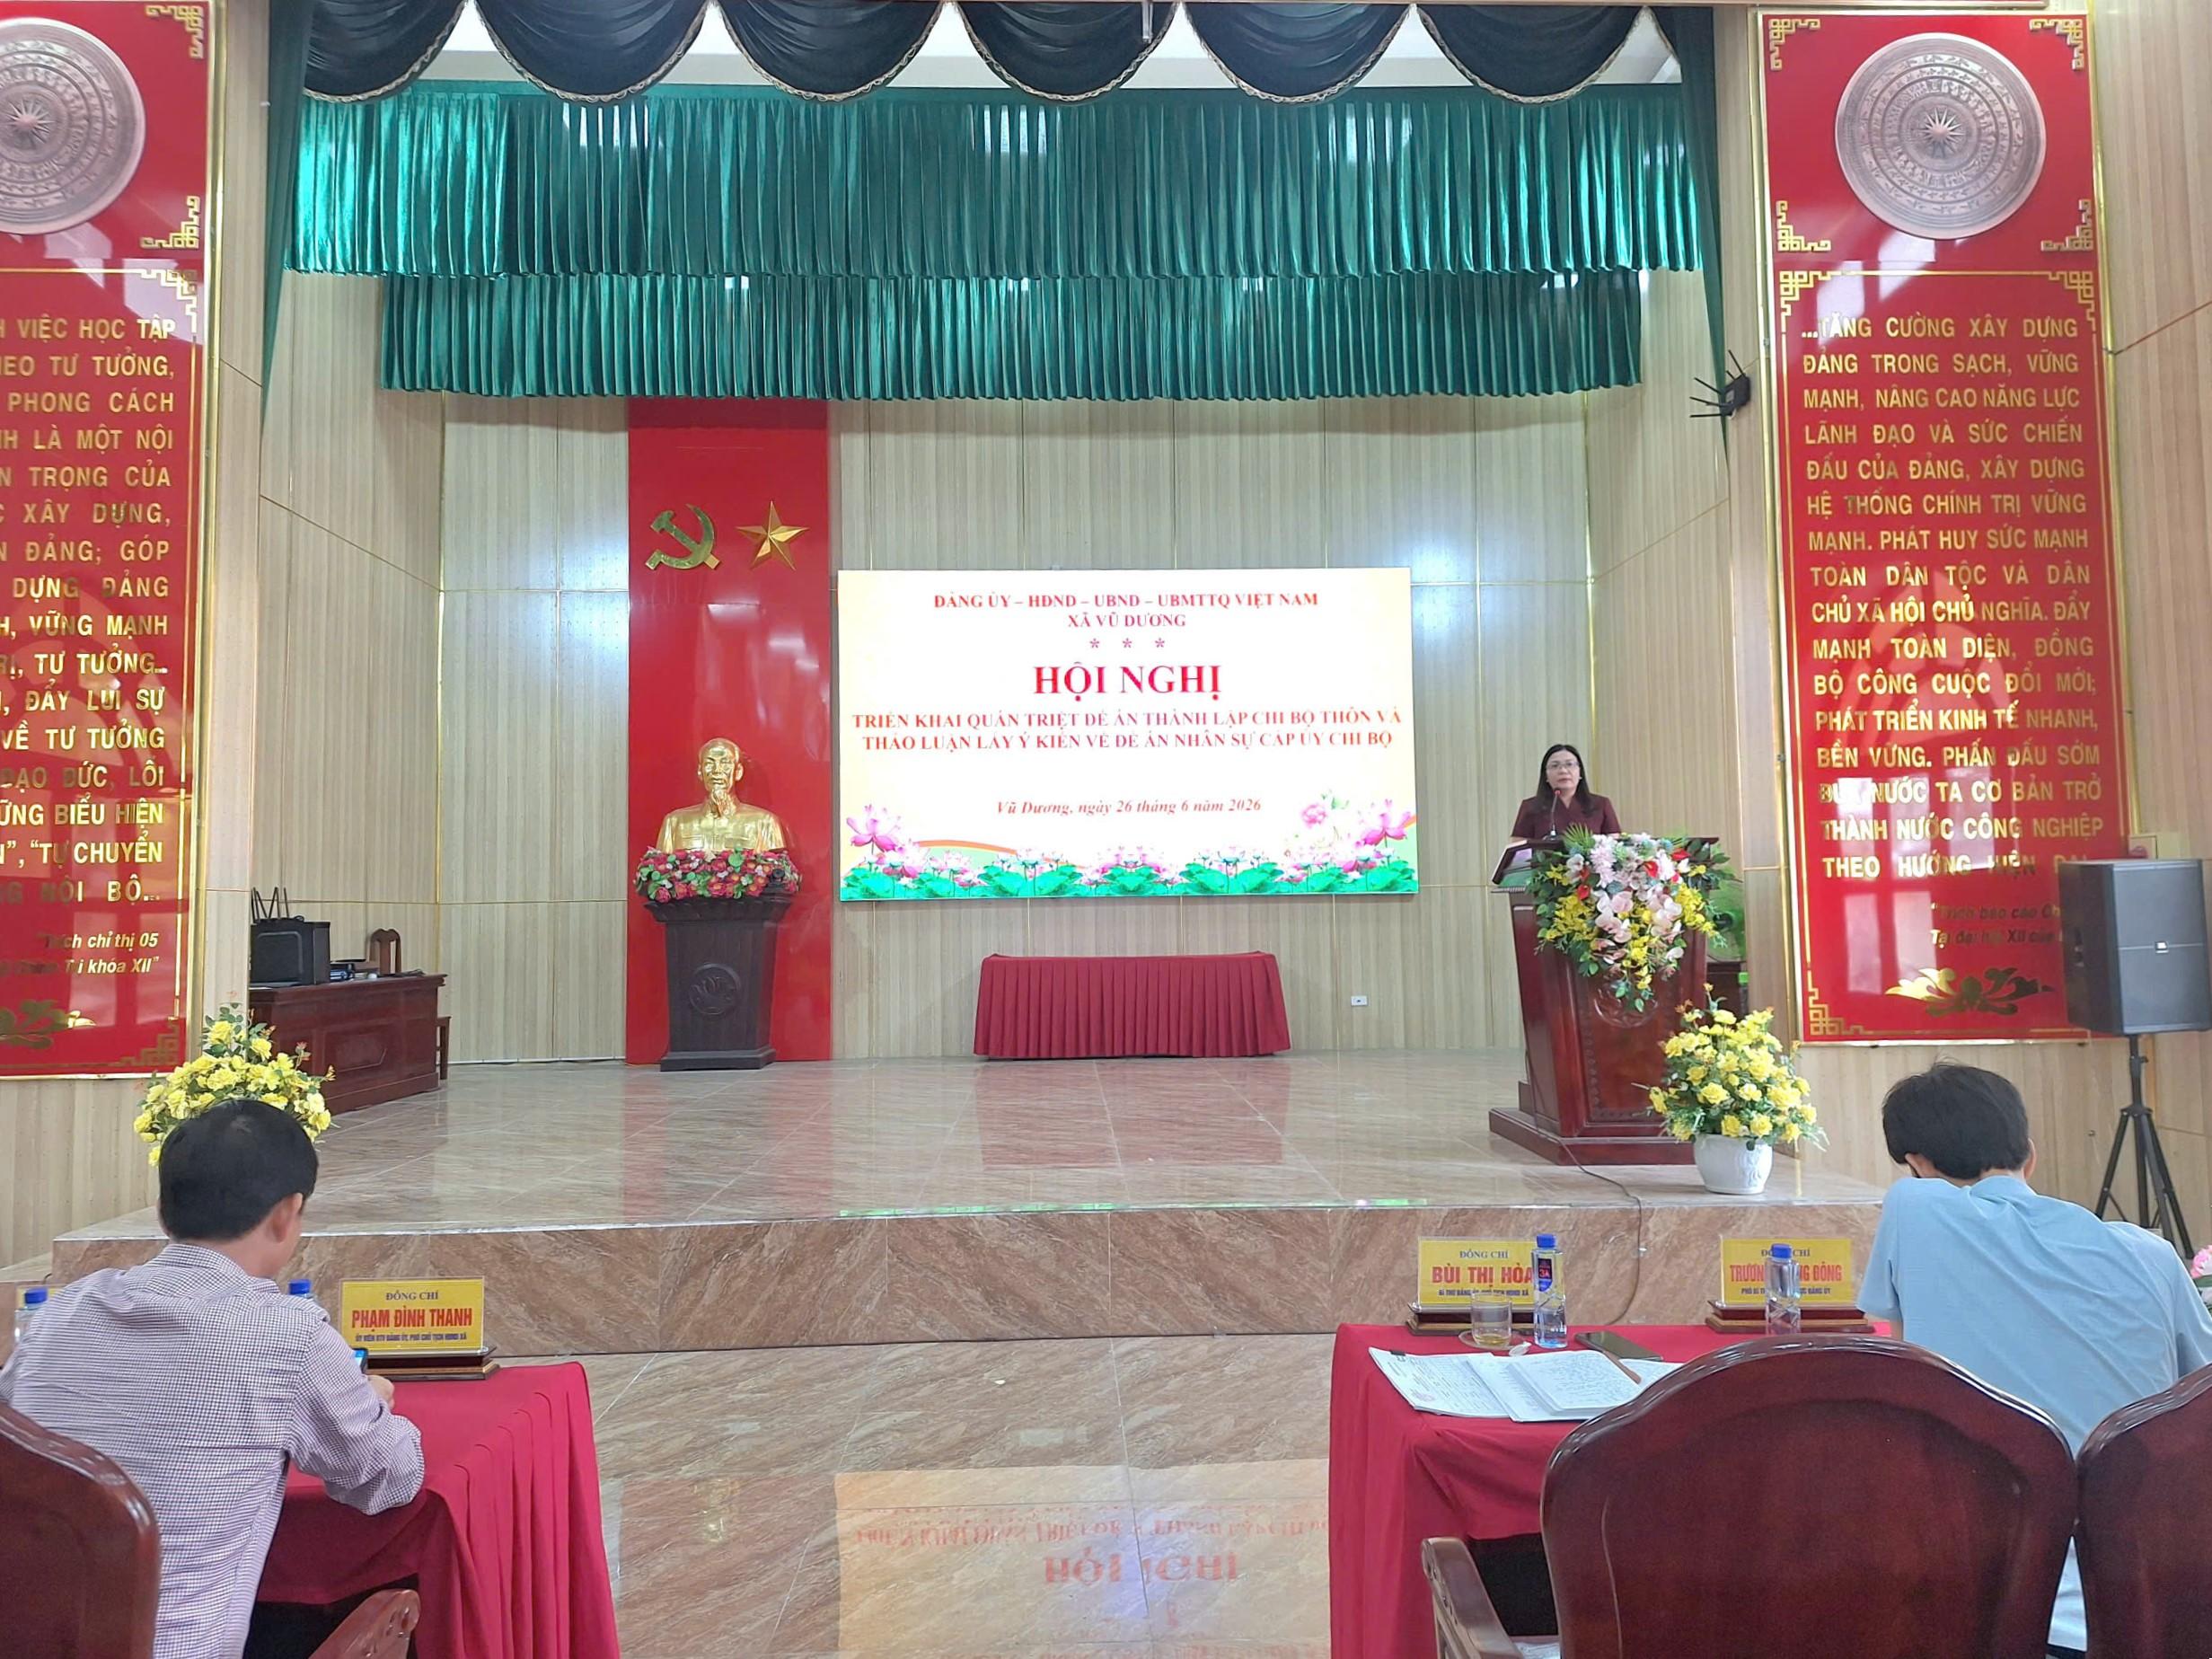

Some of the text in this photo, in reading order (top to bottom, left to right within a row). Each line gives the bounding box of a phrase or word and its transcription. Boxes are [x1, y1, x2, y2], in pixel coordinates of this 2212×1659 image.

[18, 313, 175, 344] VIỆC HỌC TẬP
[1887, 315, 1955, 338] CƯỜNG
[1970, 314, 2007, 338] XÂY
[2023, 317, 2077, 342] DỰNG
[50, 347, 173, 379] TƯ TƯỞNG,
[1803, 347, 2078, 378] ĐẢNG TRONG SẠCH, VỮNG
[8, 388, 173, 412] PHONG CÁCH
[1804, 384, 2080, 411] MẠNH, NÂNG CAO NĂNG LỰC
[34, 424, 172, 454] LÀ MỘT NỘI
[1805, 415, 2082, 448] LÃNH ĐẠO VÀ SỨC CHIẾN
[29, 460, 171, 491] TRỌNG CỦA
[1807, 452, 2084, 483] ĐẤU CỦA ĐẢNG, XÂY DỰNG
[23, 500, 171, 527] XÂY DỰNG,
[1808, 487, 2085, 519] HỆ THỐNG CHÍNH TRỊ VỮNG
[26, 534, 169, 563] ĐẢNG; GÓP
[1809, 525, 2087, 555] MẠNH. PHÁT HUY SỨC MẠNH
[13, 569, 169, 602] DỰNG ĐẢNG
[1811, 560, 2089, 590] TOÀN DÂN TỘC VÀ DÂN
[1094, 594, 1140, 607] UBND
[1158, 594, 1230, 608] UBMTTQ
[1280, 593, 1318, 605] NAM
[1811, 592, 2090, 628] CHỦ XÃ HỘI CHỦ NGHĨA. ĐẨY
[30, 611, 168, 640] VỮNG MẠNH
[1069, 612, 1186, 627] XÃ VŨ DƯƠNG
[1813, 629, 2093, 664] MẠNH TOÀN DIỆN, ĐỒNG
[34, 651, 65, 675] TƯ
[1033, 661, 1221, 702] HỘI NGHỊ
[1814, 669, 1844, 700] BỘ
[1857, 668, 1917, 695] CÔNG
[1932, 669, 1990, 698] CUỘC
[2005, 662, 2040, 693] ĐỔI
[25, 679, 165, 716] ĐẨY SỰ
[915, 714, 961, 727] KHAI
[1252, 711, 1283, 724] CHI
[1816, 698, 2098, 731] PHÁT TRIỂN KINH TẾ NHANH,
[45, 726, 76, 749] TƯ
[87, 719, 164, 750] TƯỞNG
[1019, 729, 1361, 749] Ý NHÂN SỰ CHI
[1817, 738, 2099, 768] BỀN VỮNG. PHẤN ĐẤU SỚM
[129, 759, 163, 788] LỐI
[1872, 777, 1927, 803] NƯỚC
[1935, 783, 1962, 802] TA
[1971, 781, 2001, 802] CƠ
[2013, 773, 2053, 801] BẢN
[2066, 773, 2102, 800] TRỞ
[55, 793, 163, 828] BIỂU HIỆN
[997, 801, 1017, 814] Vũ
[1117, 800, 1132, 812] 26
[1181, 799, 1188, 811] 6
[1229, 799, 1261, 811] 2026
[1821, 813, 2103, 842] THÀNH NƯỚC CÔNG NGHIỆP
[74, 832, 163, 864] CHUYỂN
[1823, 852, 1970, 878] THEO HƯỚNG
[88, 931, 112, 948] chỉ
[115, 934, 135, 951] thị
[139, 933, 158, 947] 05
[88, 957, 126, 974] khóa
[1491, 1250, 1508, 1258] CHÍ
[1432, 1263, 1534, 1287] BÙI THỊ HÒA
[1813, 1262, 1842, 1282] ĐỒNG
[419, 1290, 438, 1300] CHÍ
[352, 1305, 472, 1332] PHẠM ĐÌNH THANH
